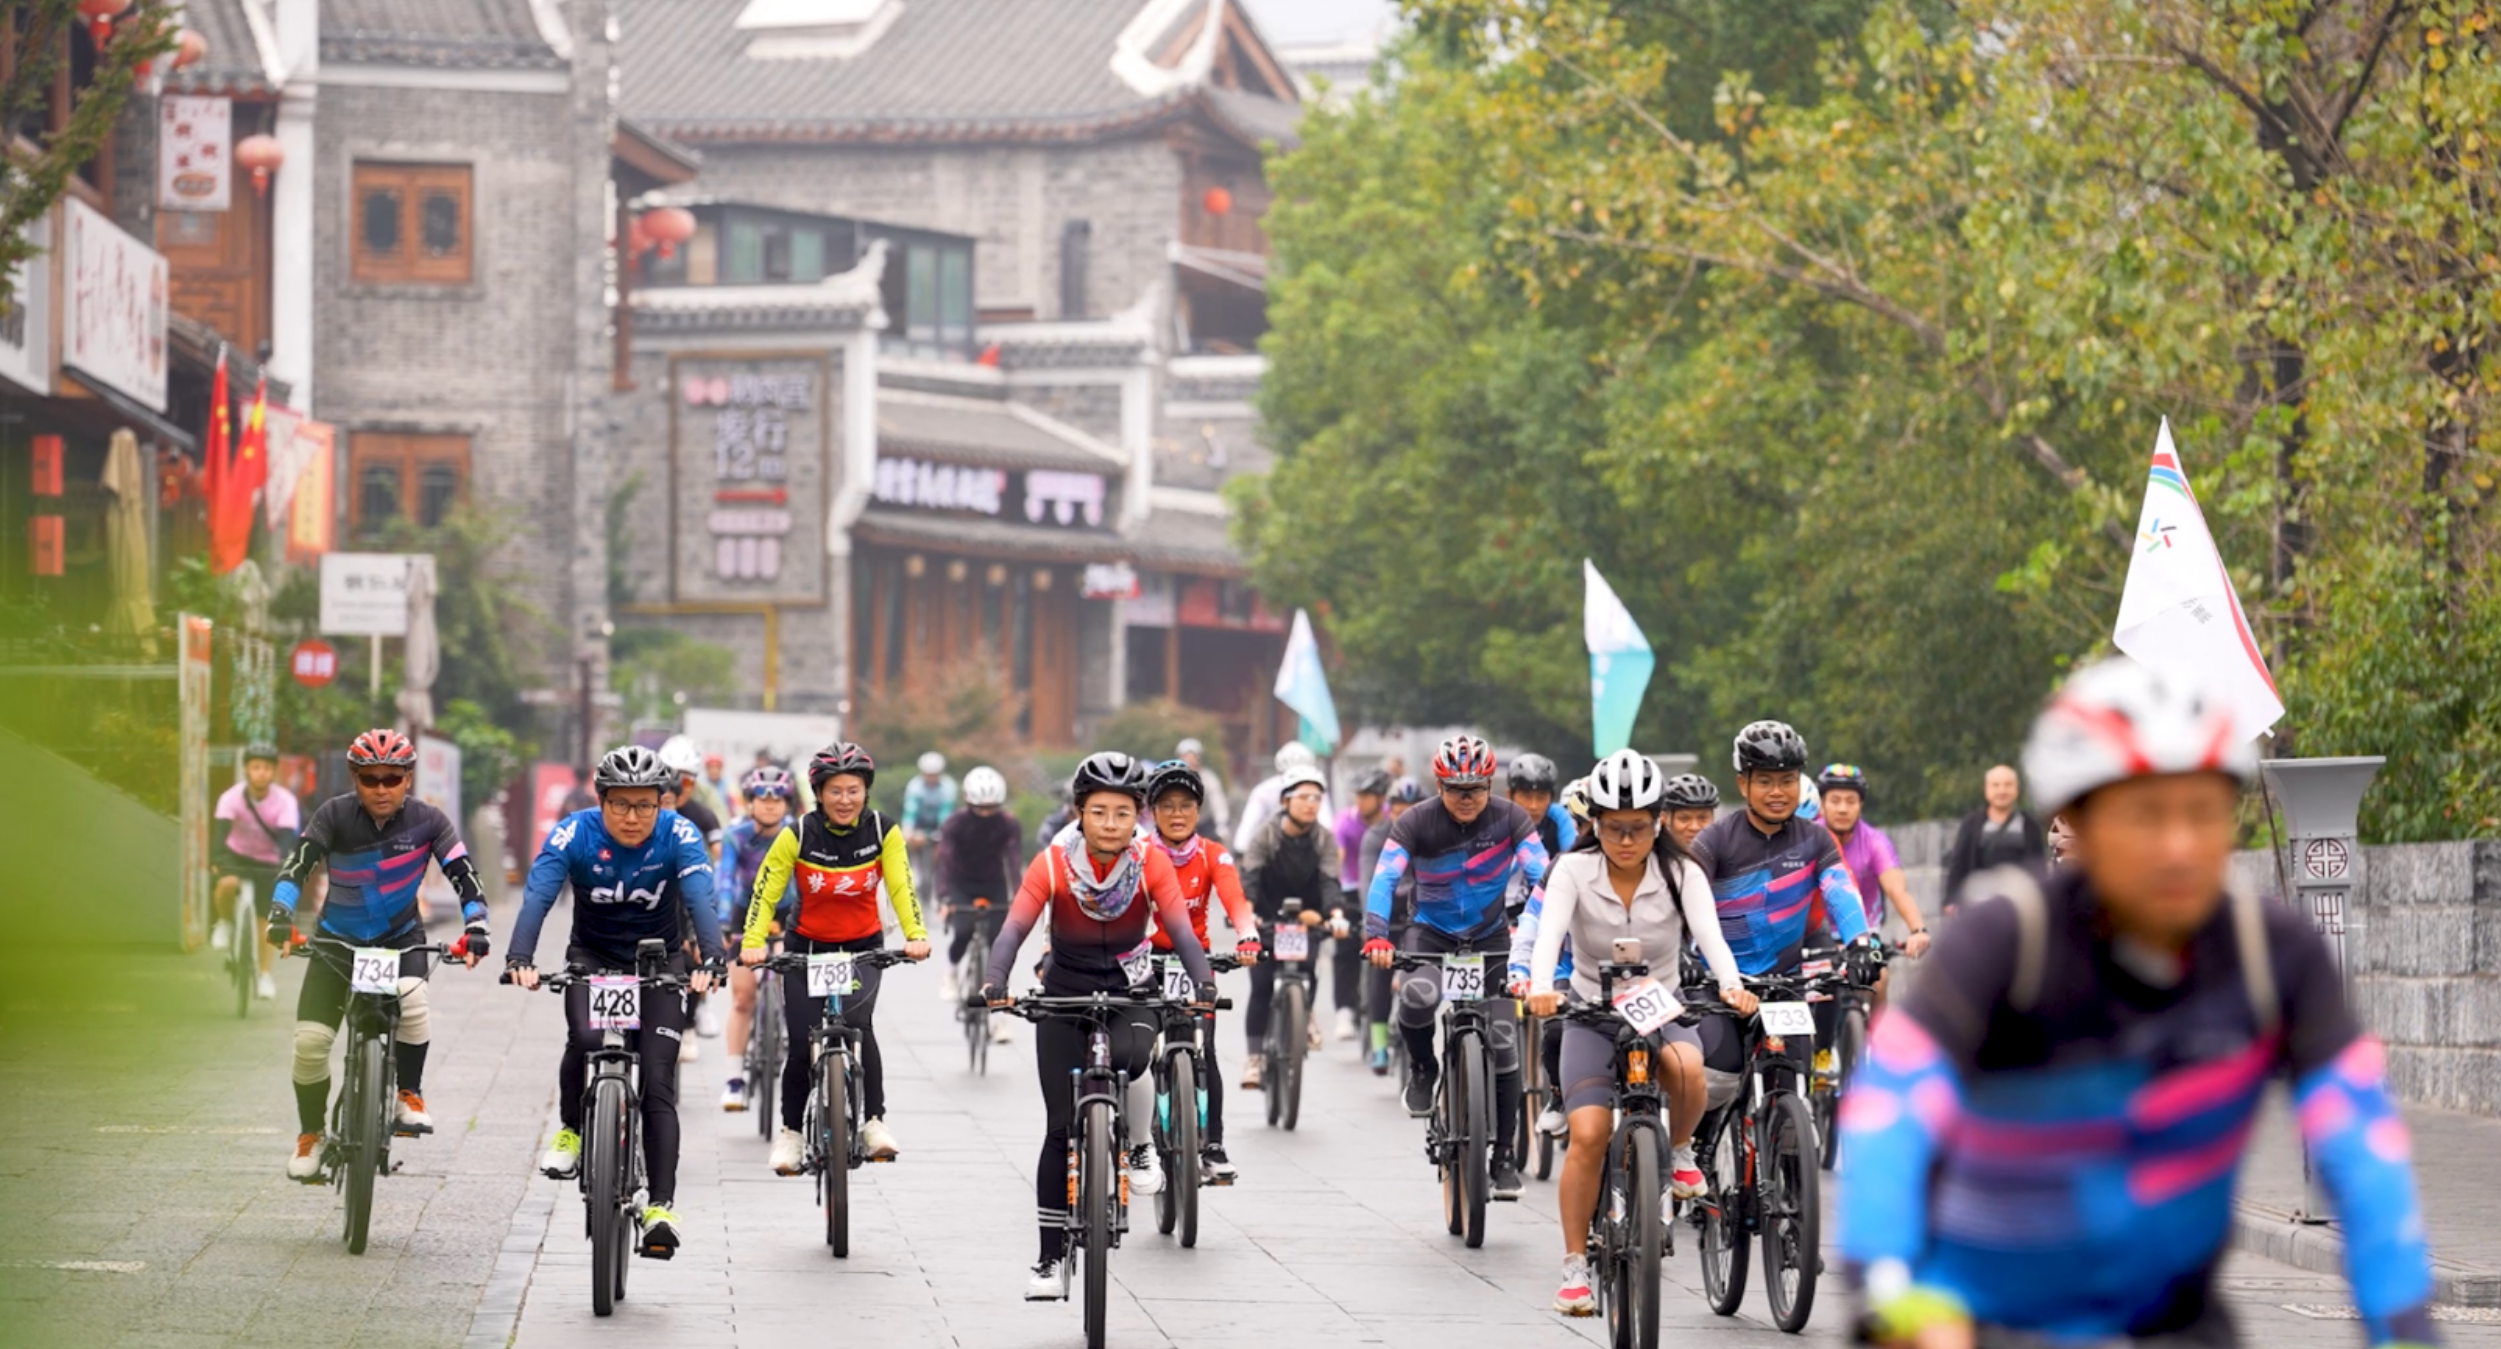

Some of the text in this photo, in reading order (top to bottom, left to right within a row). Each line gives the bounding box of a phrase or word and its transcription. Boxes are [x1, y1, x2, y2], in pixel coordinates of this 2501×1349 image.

[356, 957, 396, 983] 734
[810, 961, 848, 987] 758
[1446, 966, 1481, 991] 735
[1167, 971, 1191, 996] 76
[592, 988, 636, 1017] 428
[1624, 987, 1667, 1023] 697
[1764, 1009, 1808, 1027] 733
